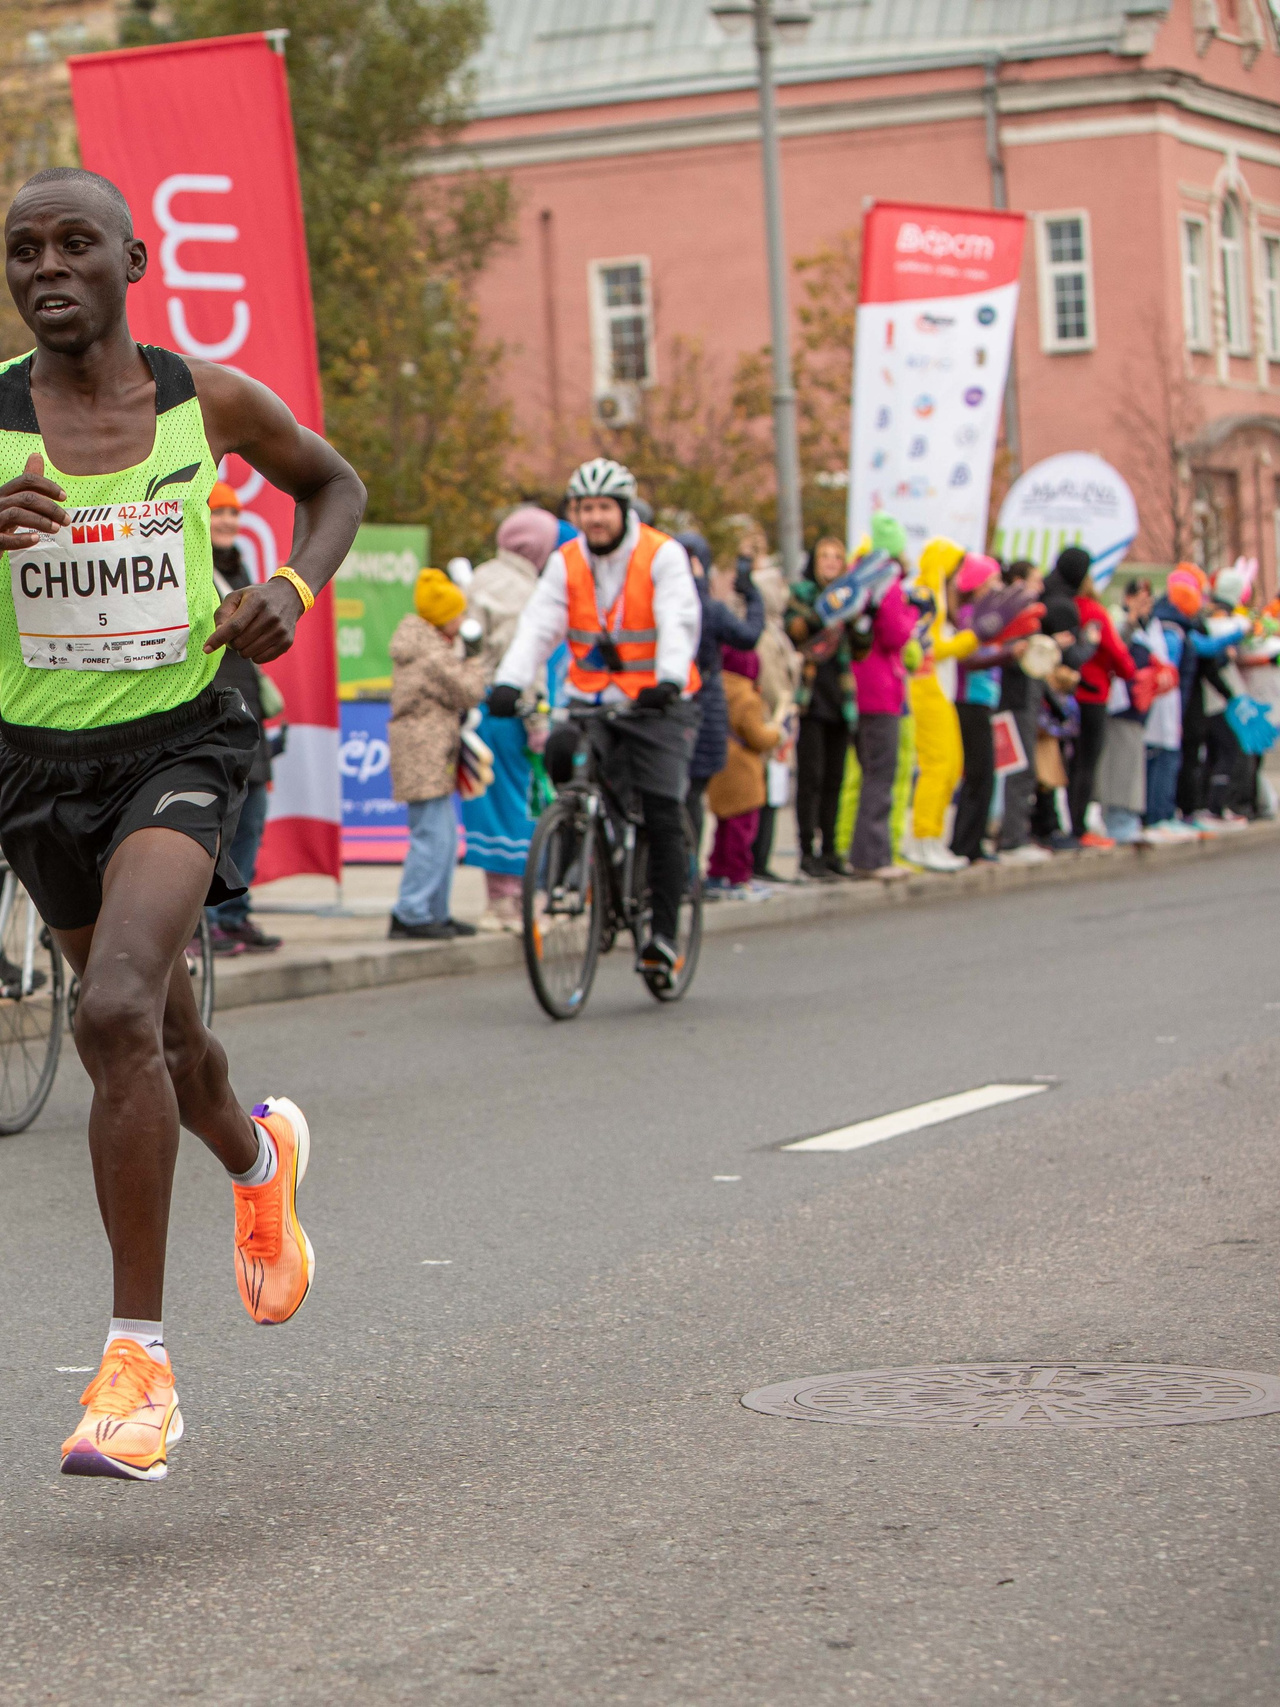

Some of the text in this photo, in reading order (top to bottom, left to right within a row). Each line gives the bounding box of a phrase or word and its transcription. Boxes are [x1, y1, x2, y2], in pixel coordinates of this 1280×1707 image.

[117, 503, 152, 520] 42,2
[20, 552, 180, 599] CHUMBA
[98, 613, 108, 627] 5
[140, 638, 166, 647] СИБУР
[132, 654, 154, 662] МАГНИТ
